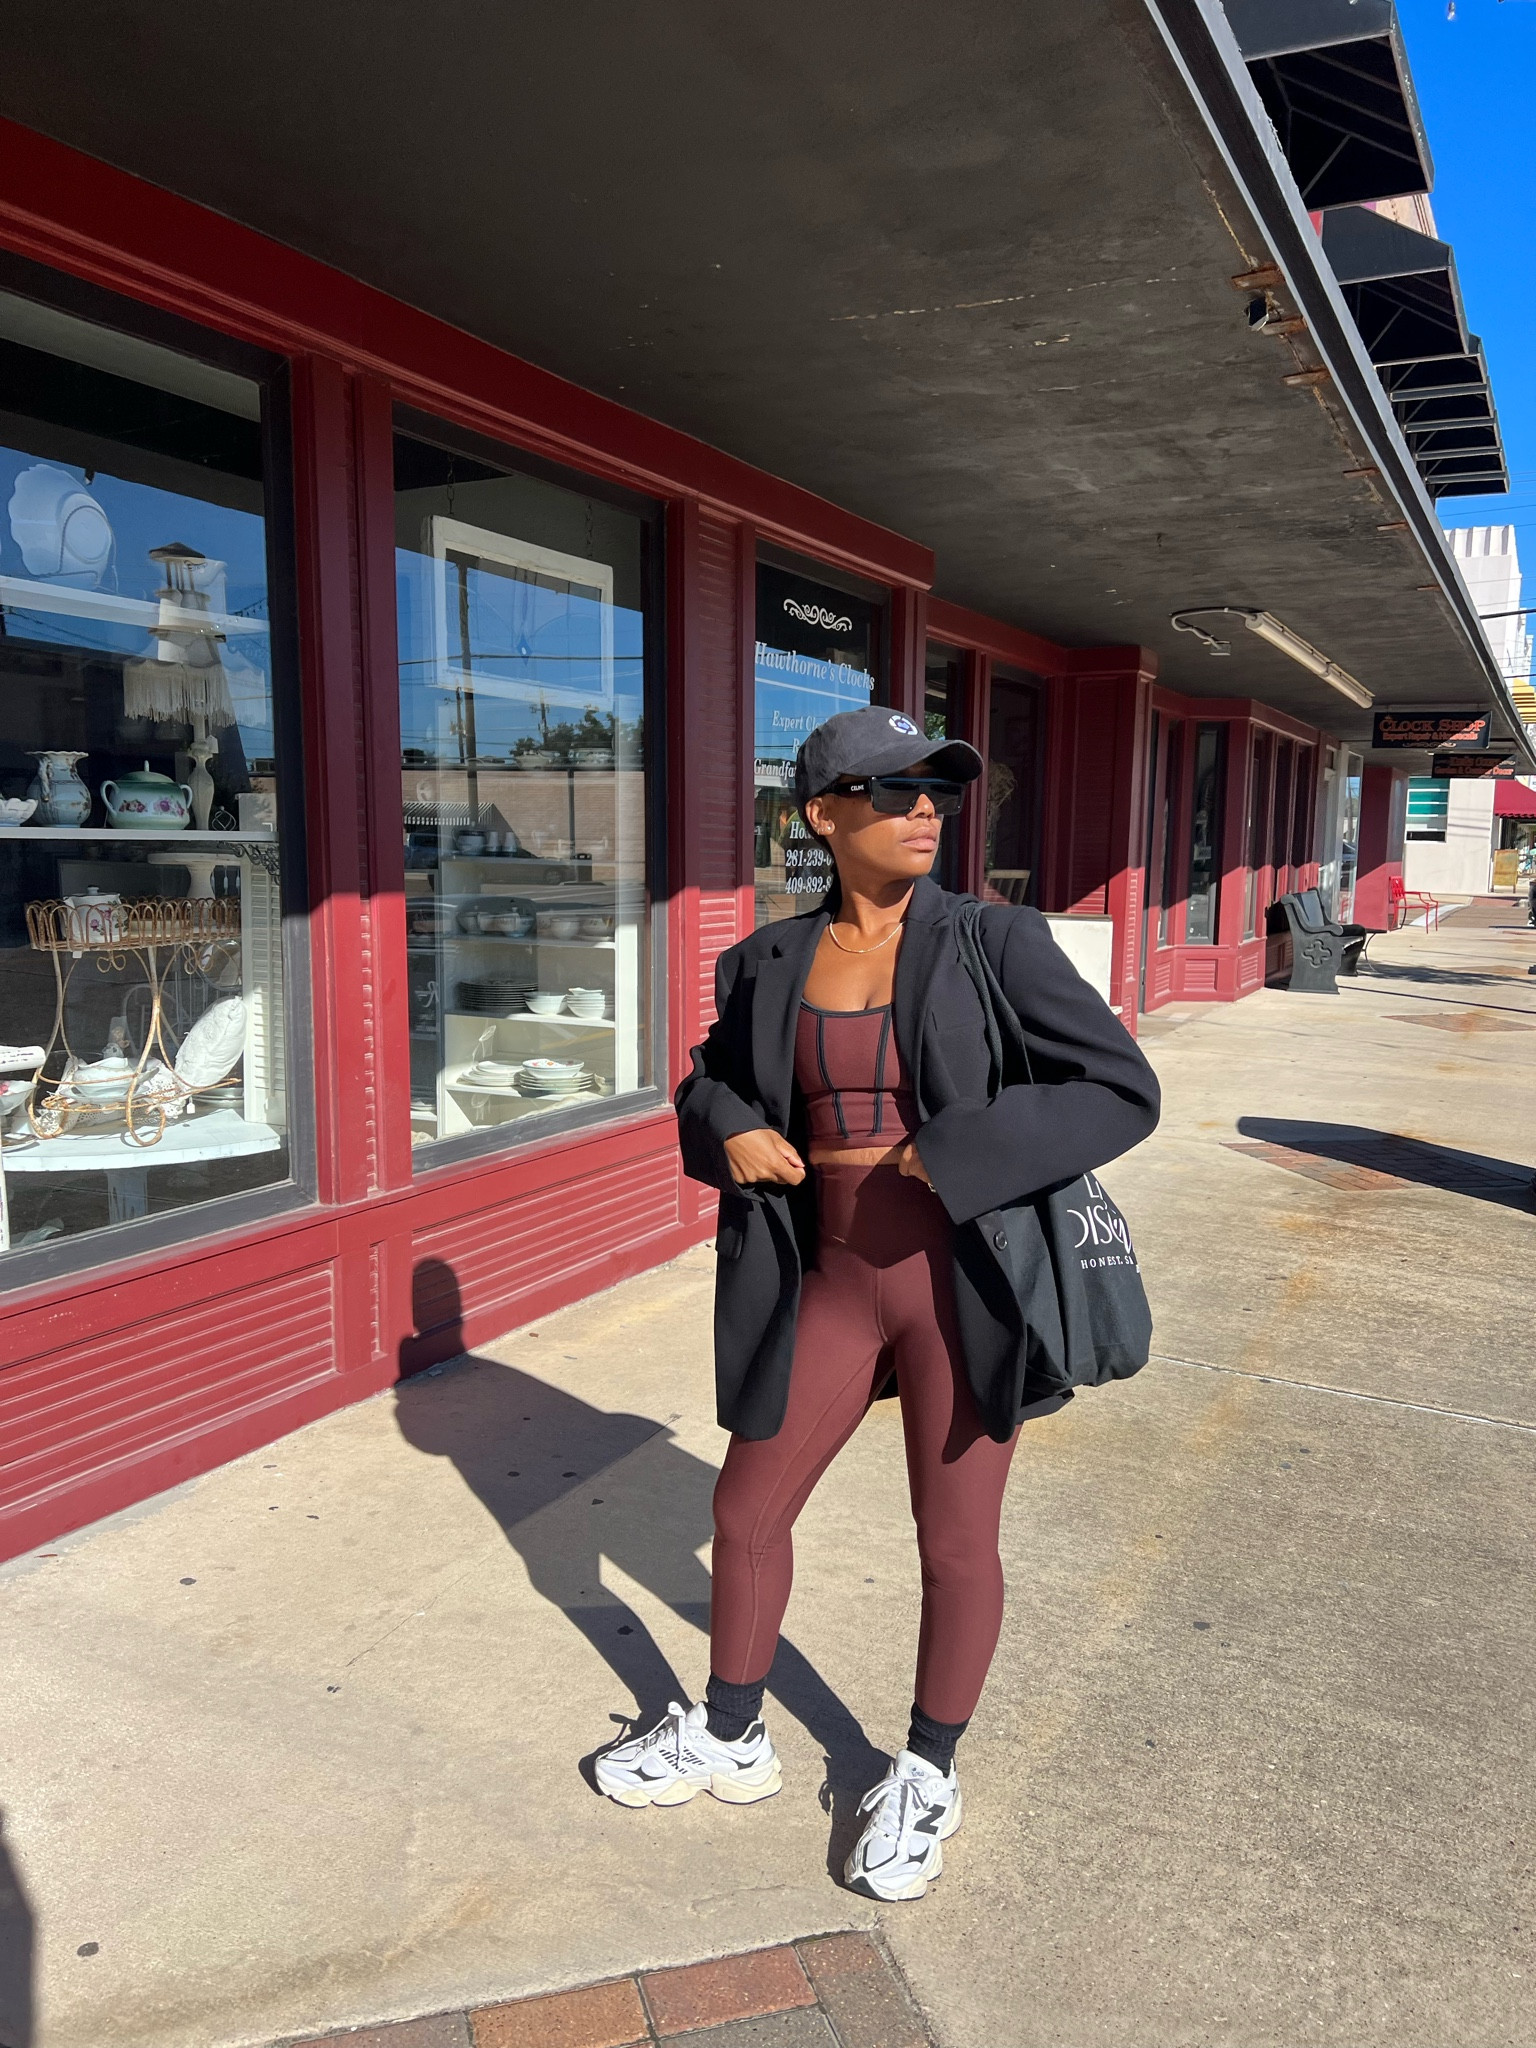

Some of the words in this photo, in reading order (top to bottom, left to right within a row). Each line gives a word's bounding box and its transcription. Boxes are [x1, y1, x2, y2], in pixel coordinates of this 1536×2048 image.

[754, 640, 836, 682] Hawthorne's
[838, 662, 875, 691] Clocks
[772, 710, 804, 732] Expert
[754, 758, 797, 781] Grandfa
[785, 876, 833, 894] 409-892-8
